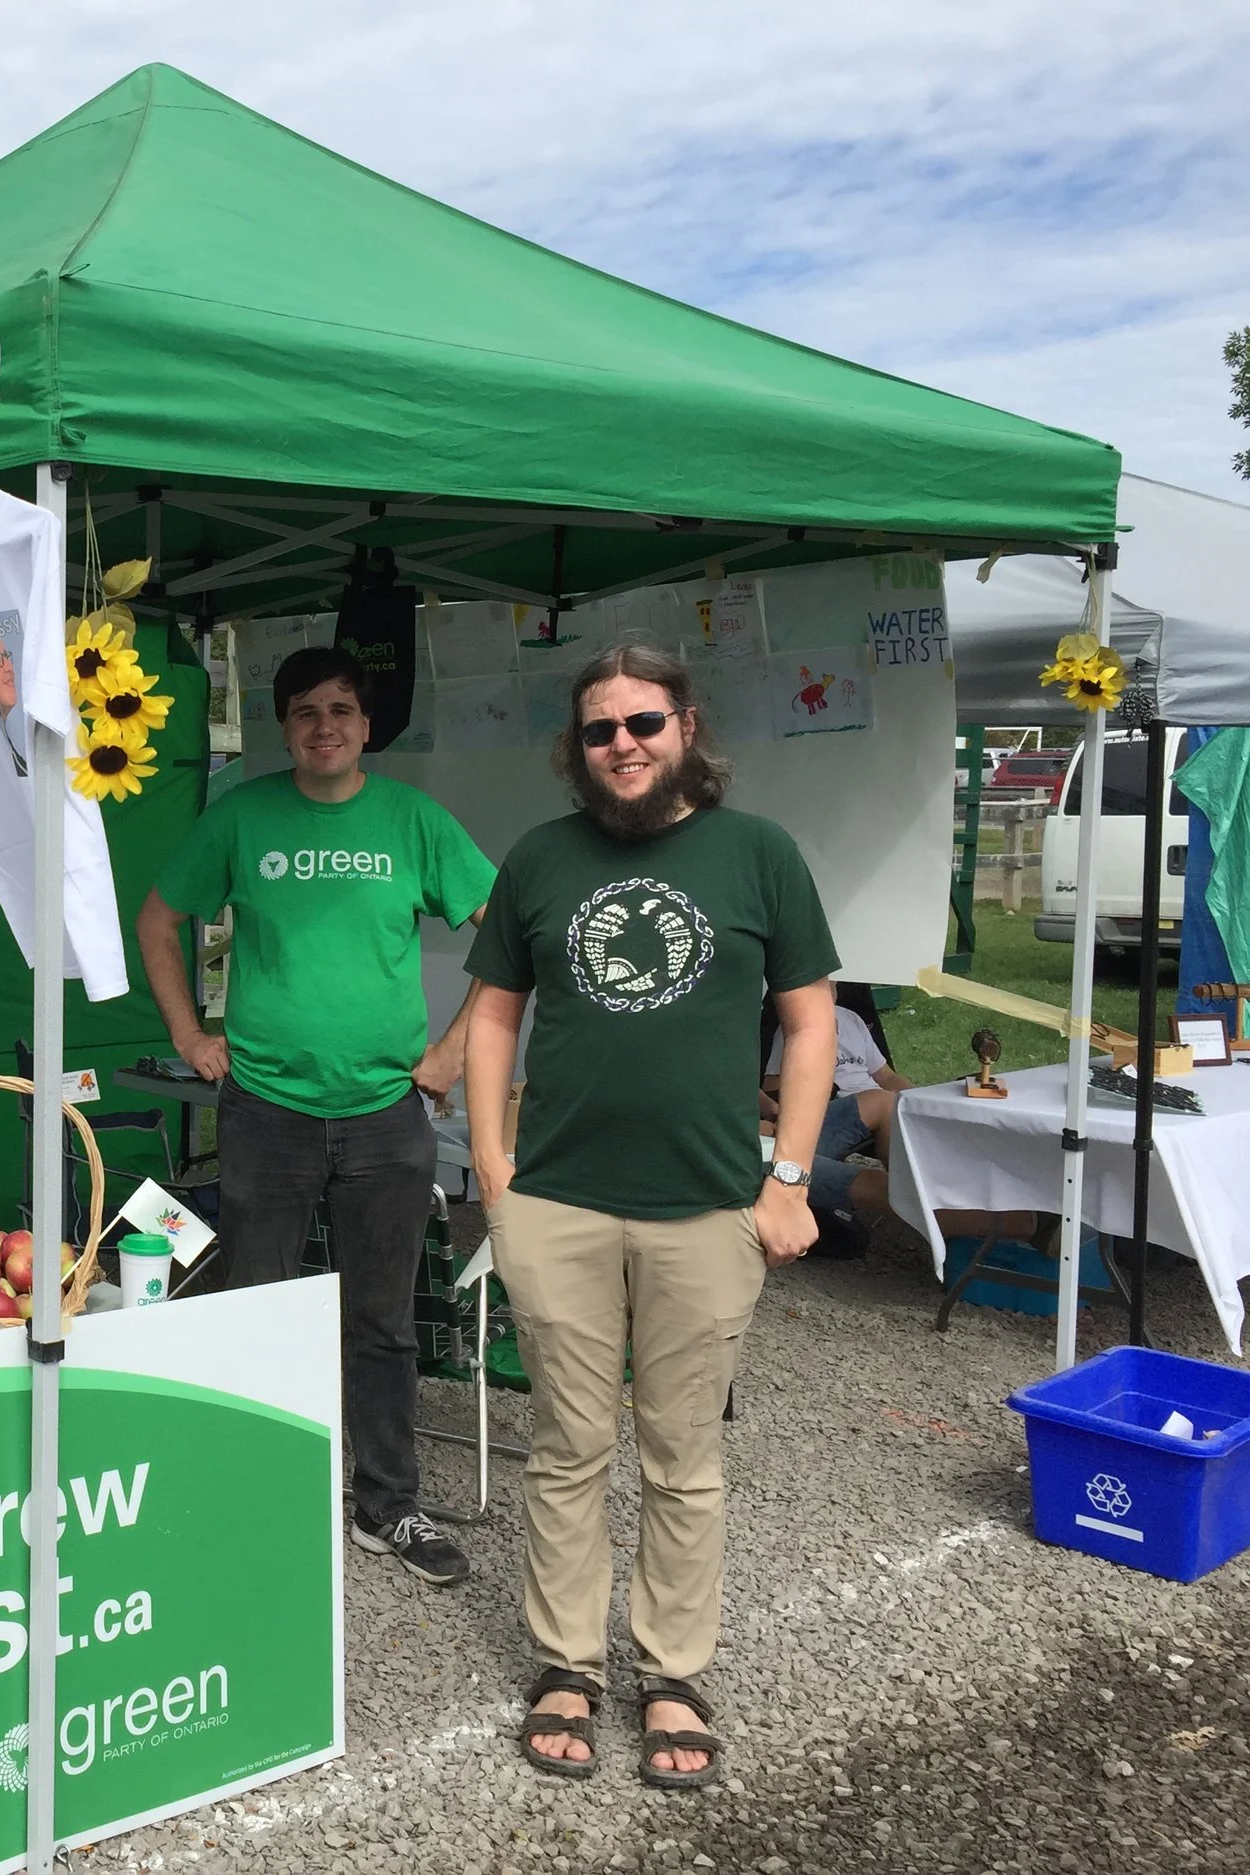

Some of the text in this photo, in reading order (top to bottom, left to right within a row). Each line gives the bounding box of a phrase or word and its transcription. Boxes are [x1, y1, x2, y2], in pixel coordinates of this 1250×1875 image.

[867, 607, 945, 636] WATER
[874, 637, 949, 665] FIRST
[294, 850, 392, 880] green
[59, 1664, 229, 1776] green
[103, 1712, 229, 1762] PARTY OF ONTARIO
